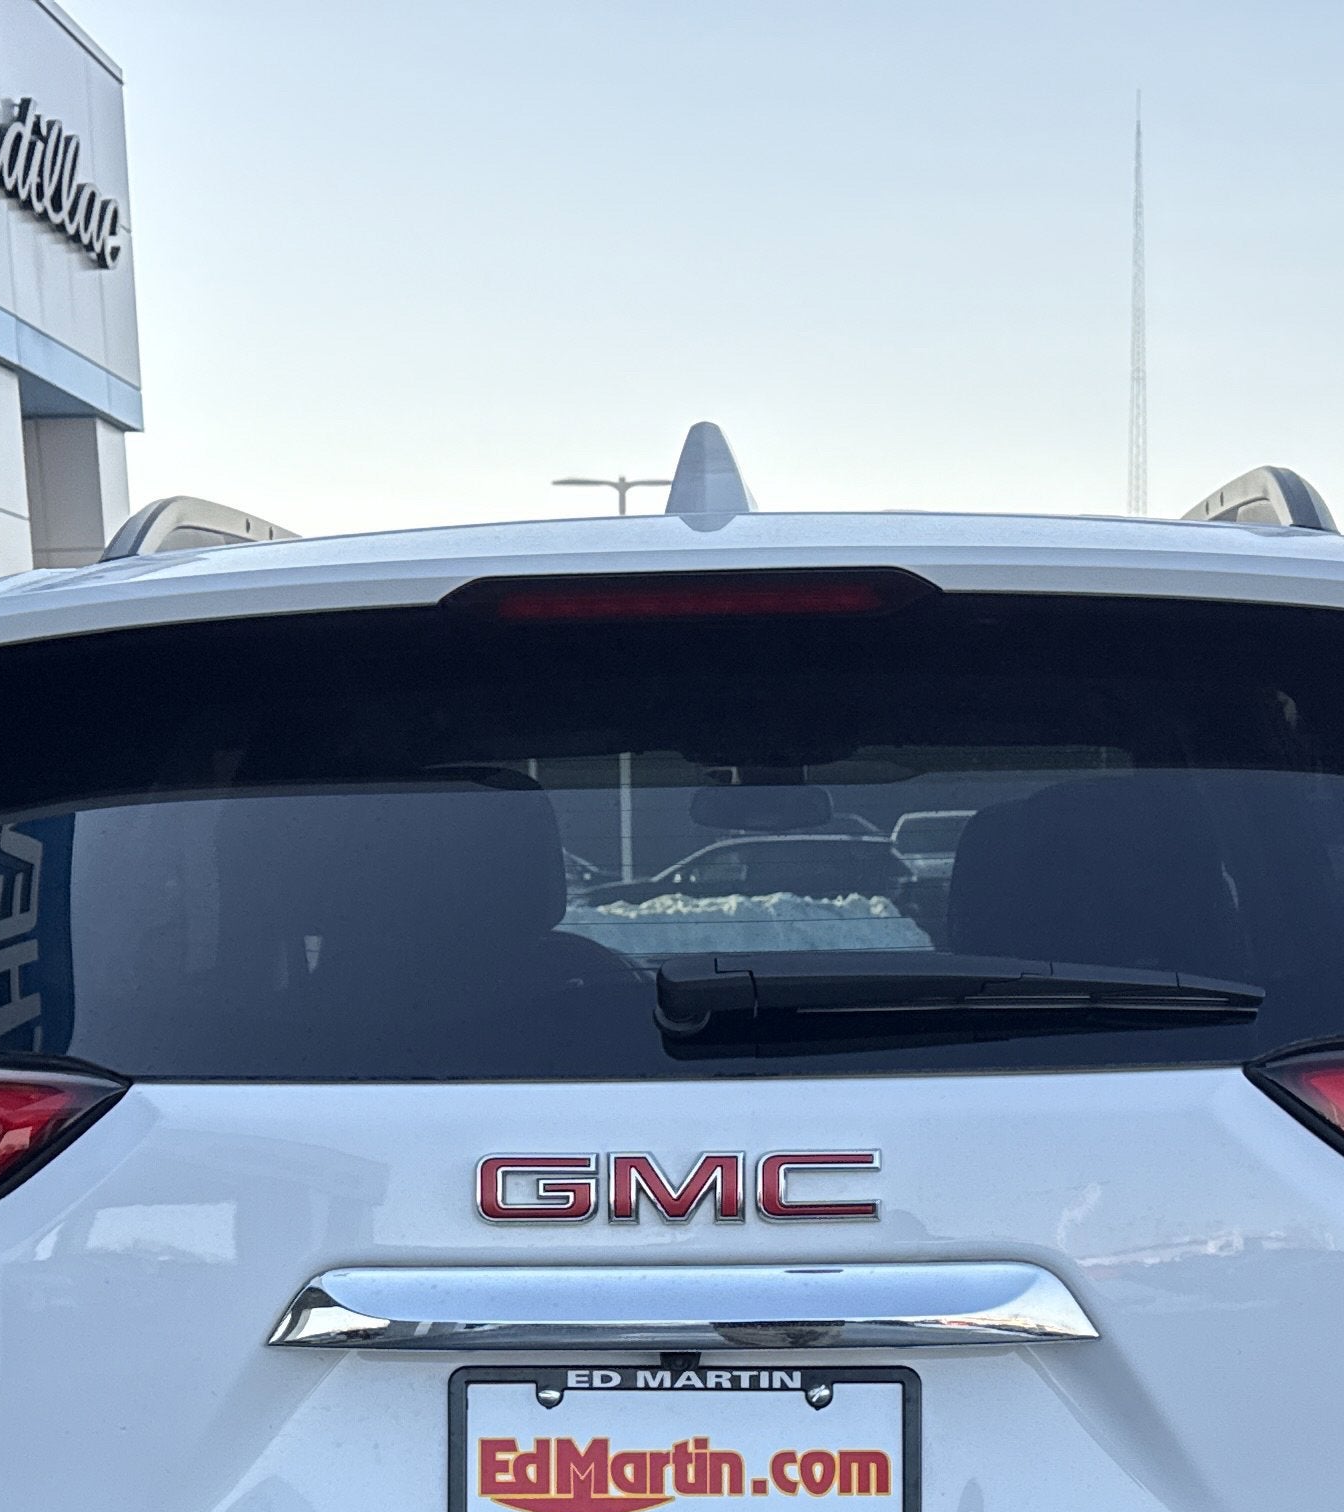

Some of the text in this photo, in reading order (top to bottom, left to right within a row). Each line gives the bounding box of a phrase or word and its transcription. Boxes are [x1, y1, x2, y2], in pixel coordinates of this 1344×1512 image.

[475, 1148, 882, 1225] GMC
[567, 1370, 802, 1389] ED MARTIN
[477, 1436, 892, 1499] EdMartin.com
